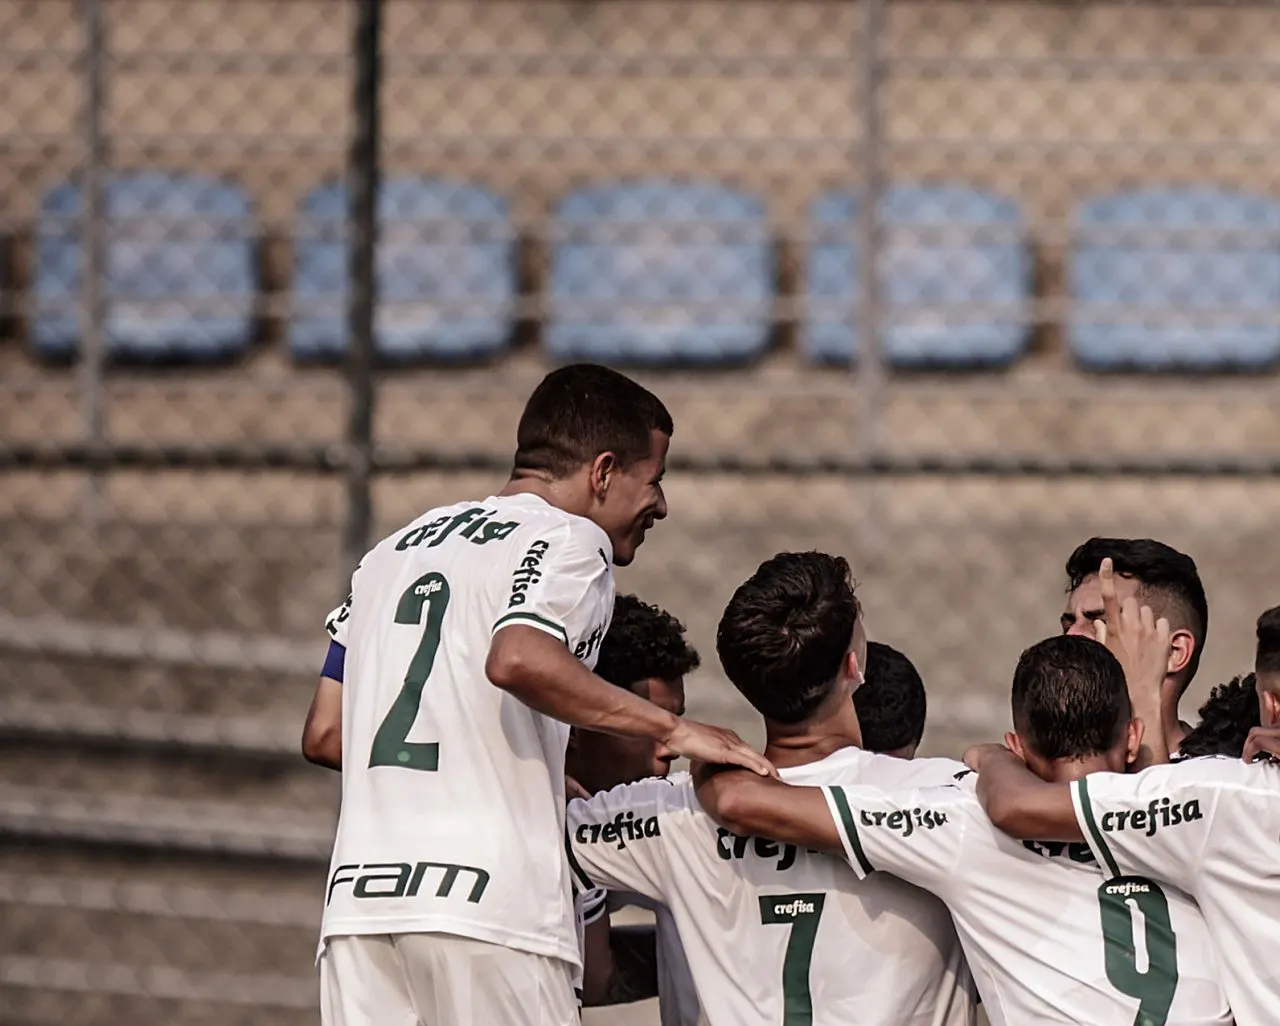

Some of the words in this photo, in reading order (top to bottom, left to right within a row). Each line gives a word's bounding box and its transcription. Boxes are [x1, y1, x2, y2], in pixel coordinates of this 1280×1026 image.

[508, 540, 550, 609] crefisa
[368, 571, 450, 772] 2
[576, 811, 661, 850] crefisa
[1101, 797, 1203, 837] crefisa
[774, 899, 815, 918] crefisa
[1105, 882, 1150, 897] crefisa
